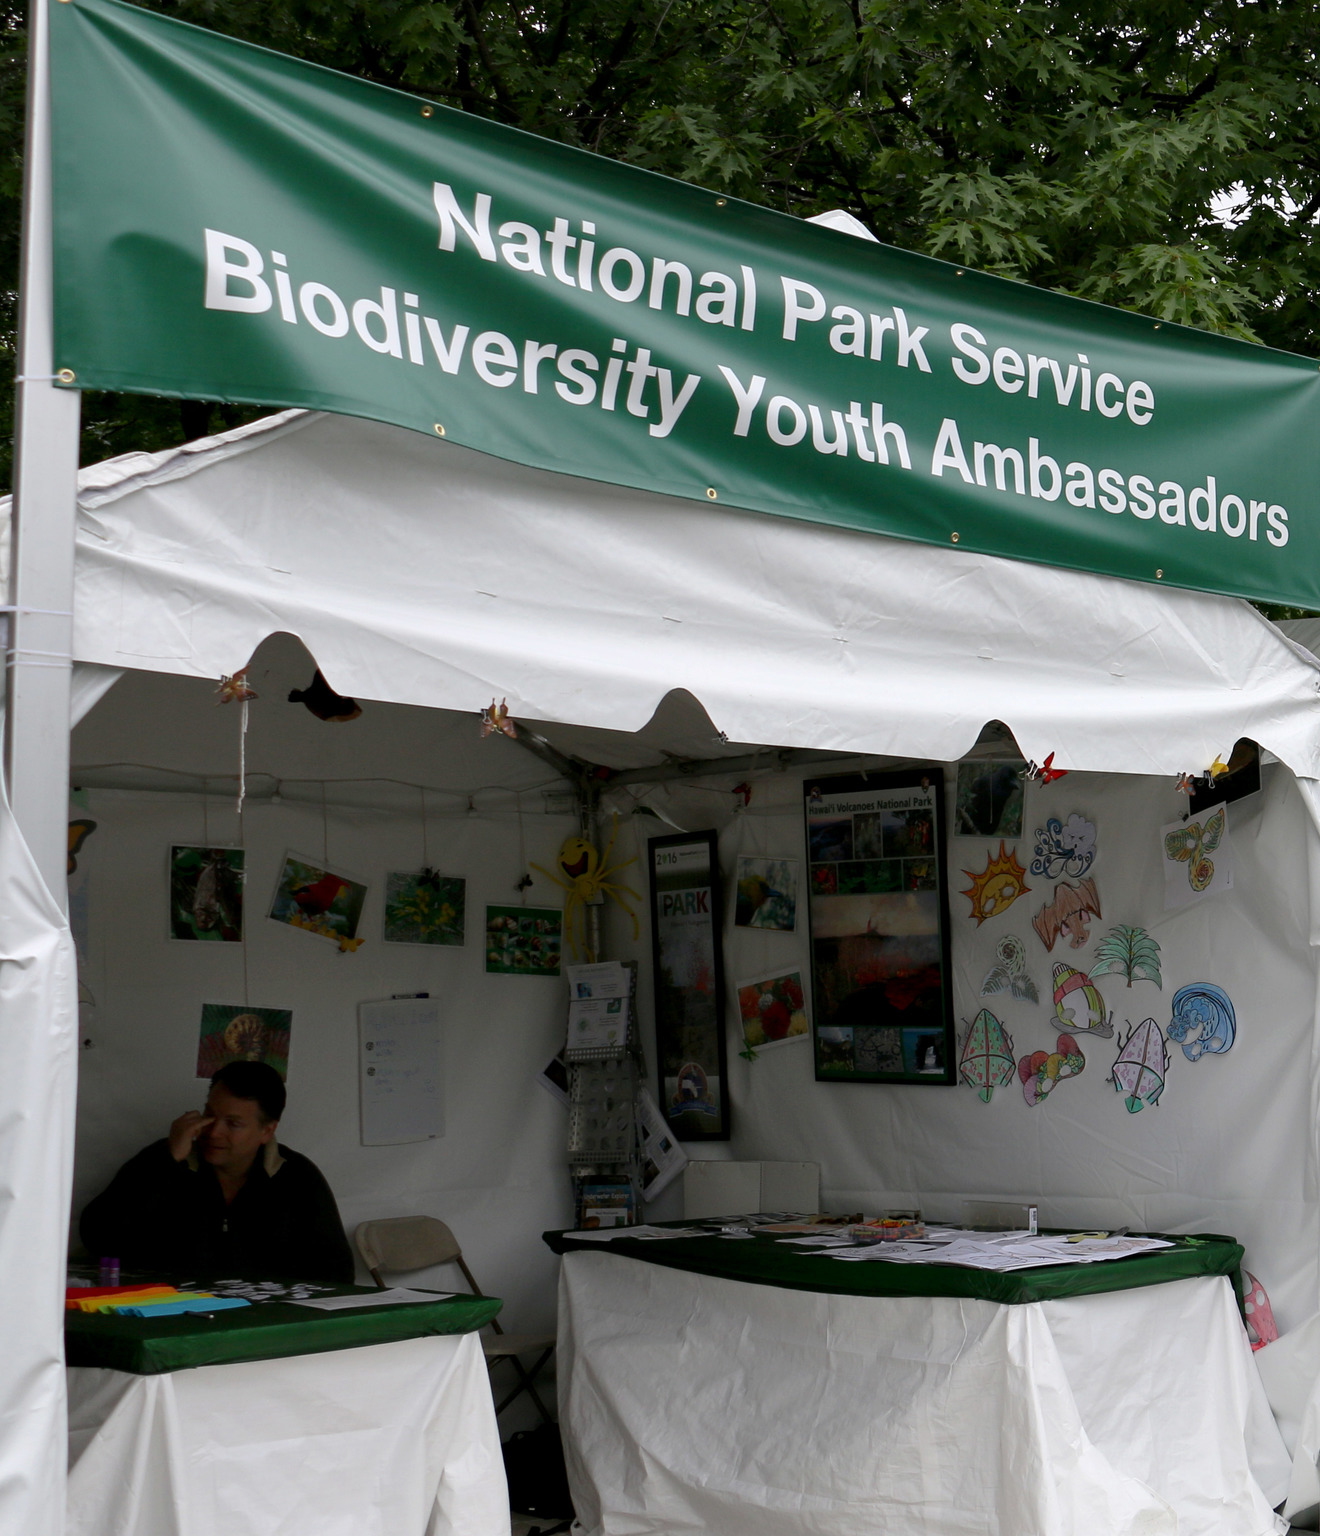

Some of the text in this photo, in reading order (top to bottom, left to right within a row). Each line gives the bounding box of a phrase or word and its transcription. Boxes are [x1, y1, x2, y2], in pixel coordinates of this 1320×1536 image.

[433, 181, 1156, 426] National Park Service
[203, 228, 1290, 548] Biodiversity Youth Ambassadors
[836, 801, 875, 813] Volcanoes
[876, 797, 911, 810] National
[913, 795, 933, 808] Park
[663, 890, 709, 918] PARK
